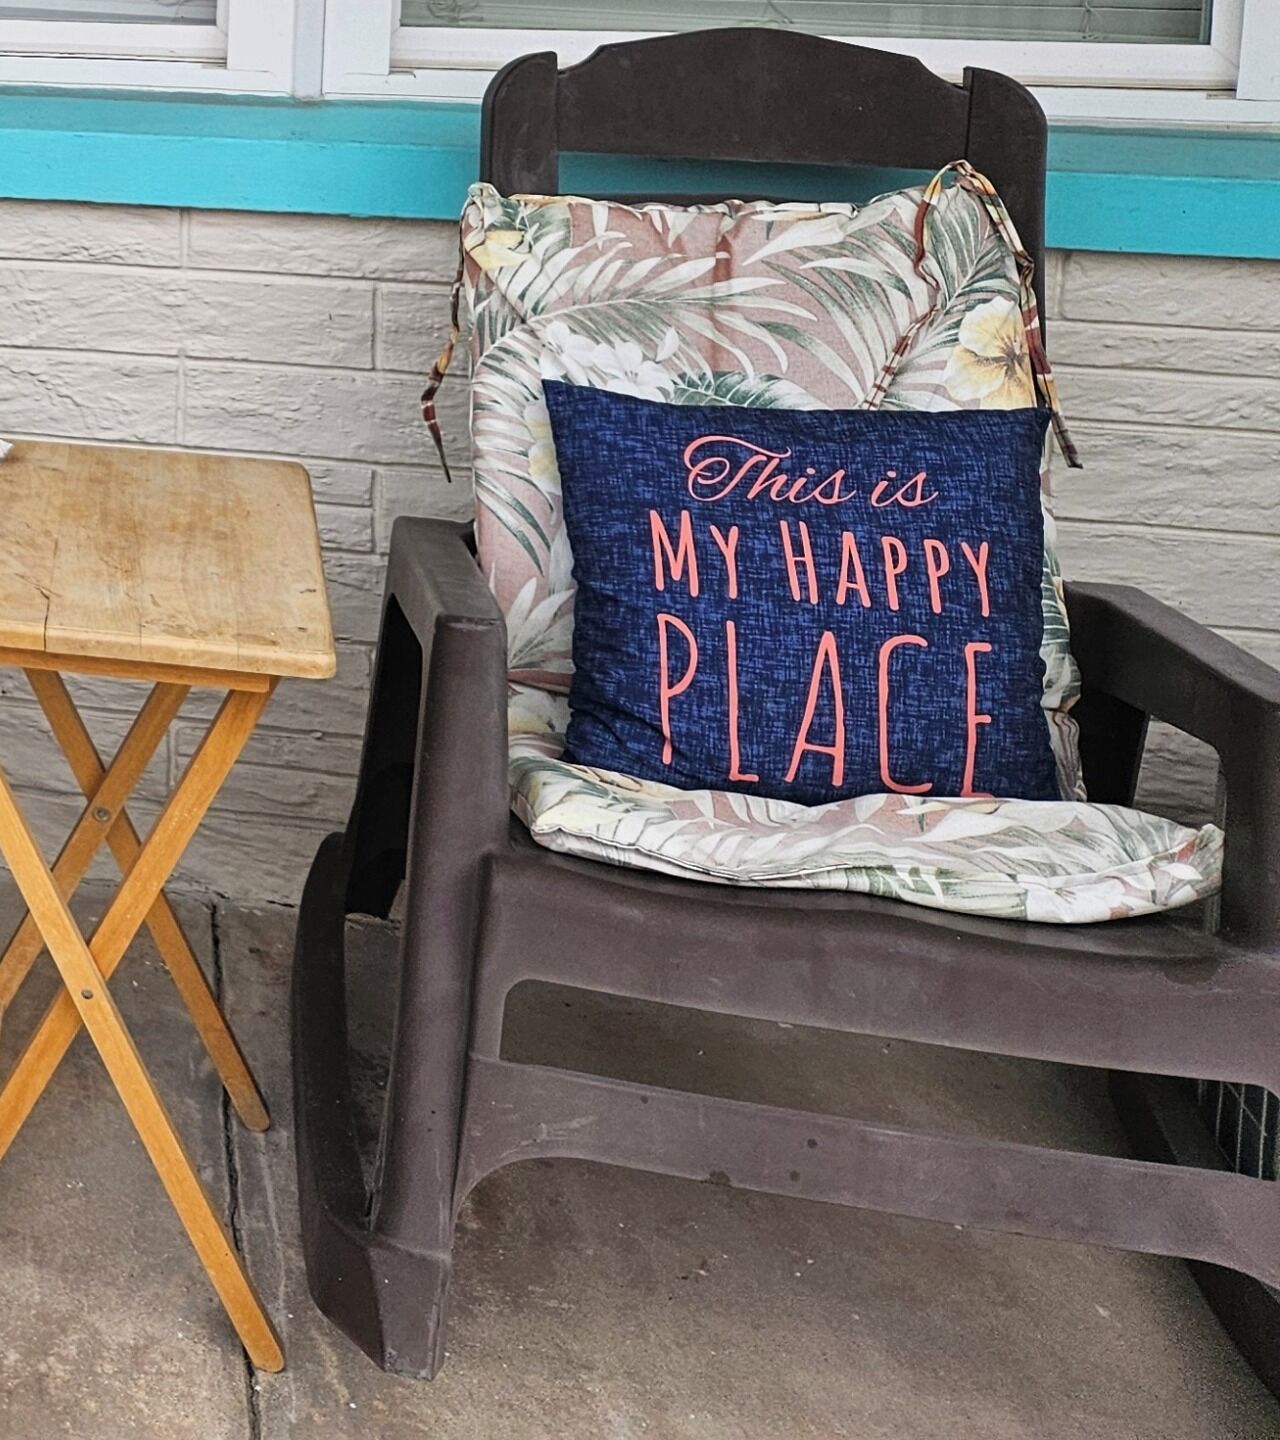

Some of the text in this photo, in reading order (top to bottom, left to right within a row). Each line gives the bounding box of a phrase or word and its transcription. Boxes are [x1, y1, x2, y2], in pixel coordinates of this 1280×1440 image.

[683, 435, 940, 509] This is
[649, 509, 990, 618] MY HAPPY
[656, 612, 993, 800] PLACE
